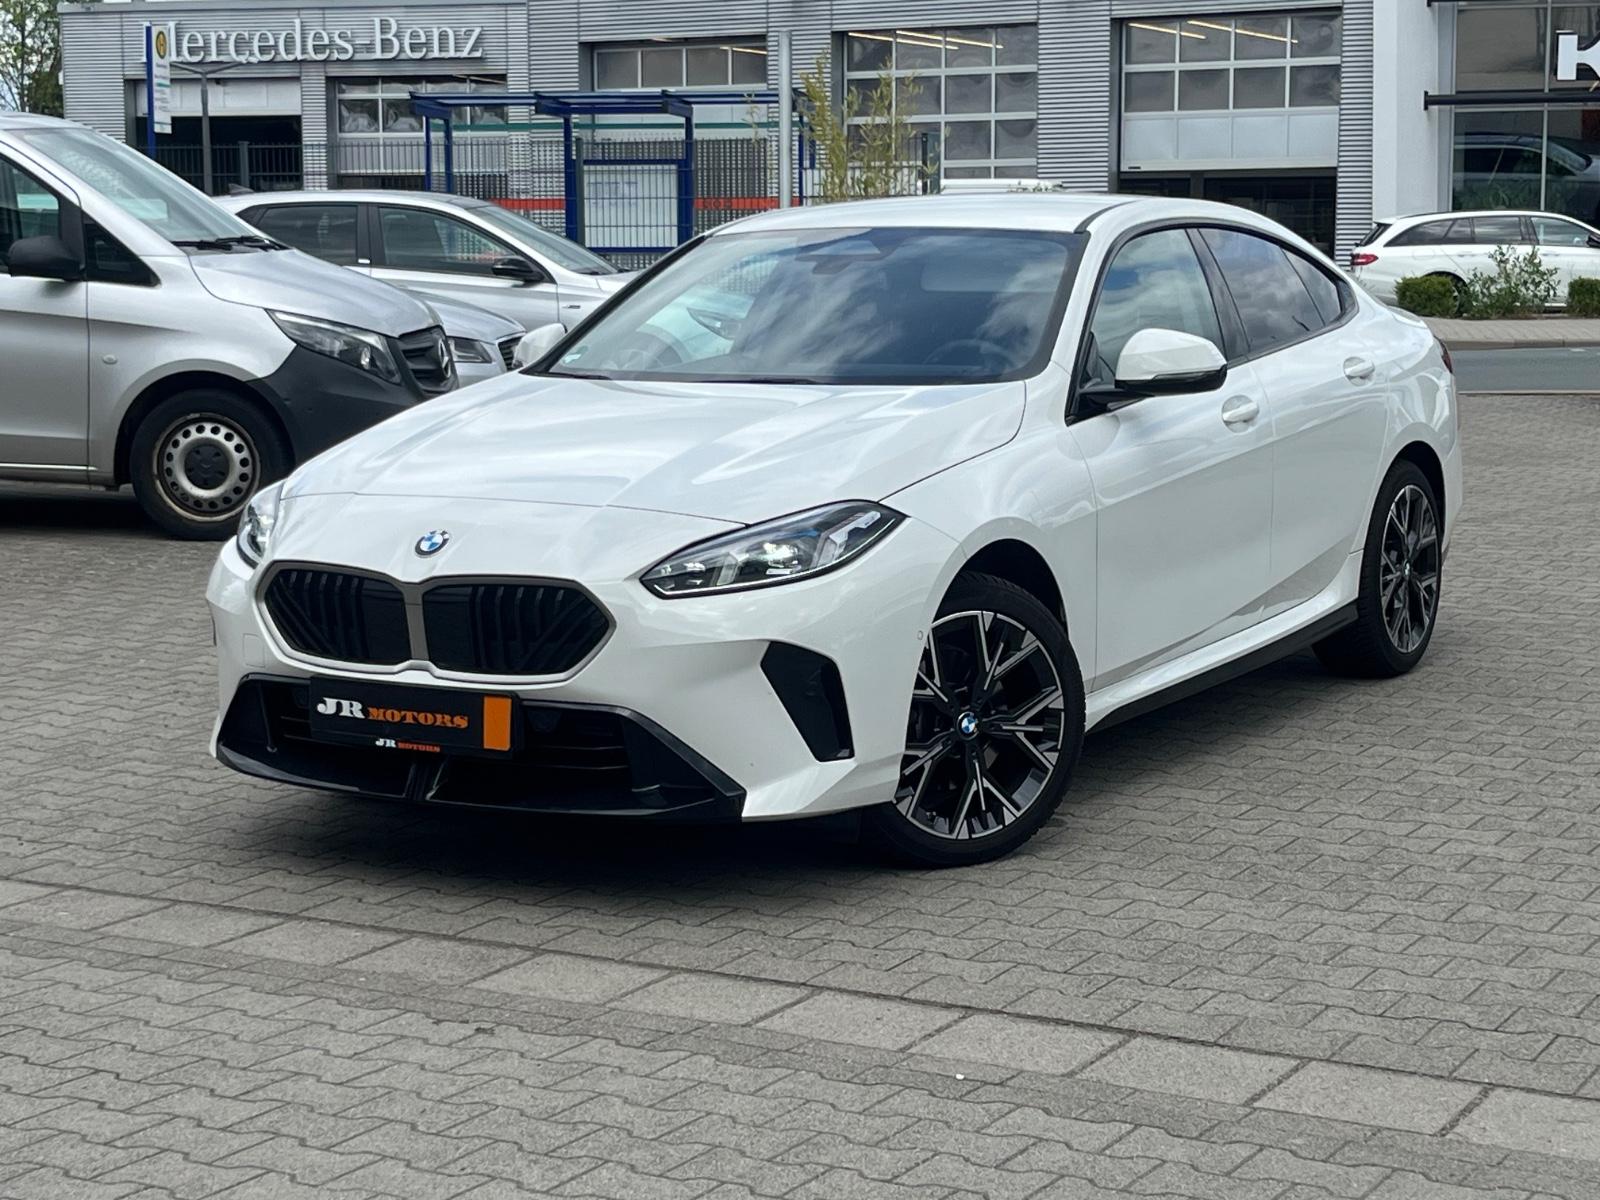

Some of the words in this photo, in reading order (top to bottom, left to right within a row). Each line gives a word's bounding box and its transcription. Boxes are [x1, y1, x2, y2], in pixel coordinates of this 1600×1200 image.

[316, 697, 365, 719] JR
[367, 707, 469, 729] MOTORS
[375, 738, 396, 748] JR
